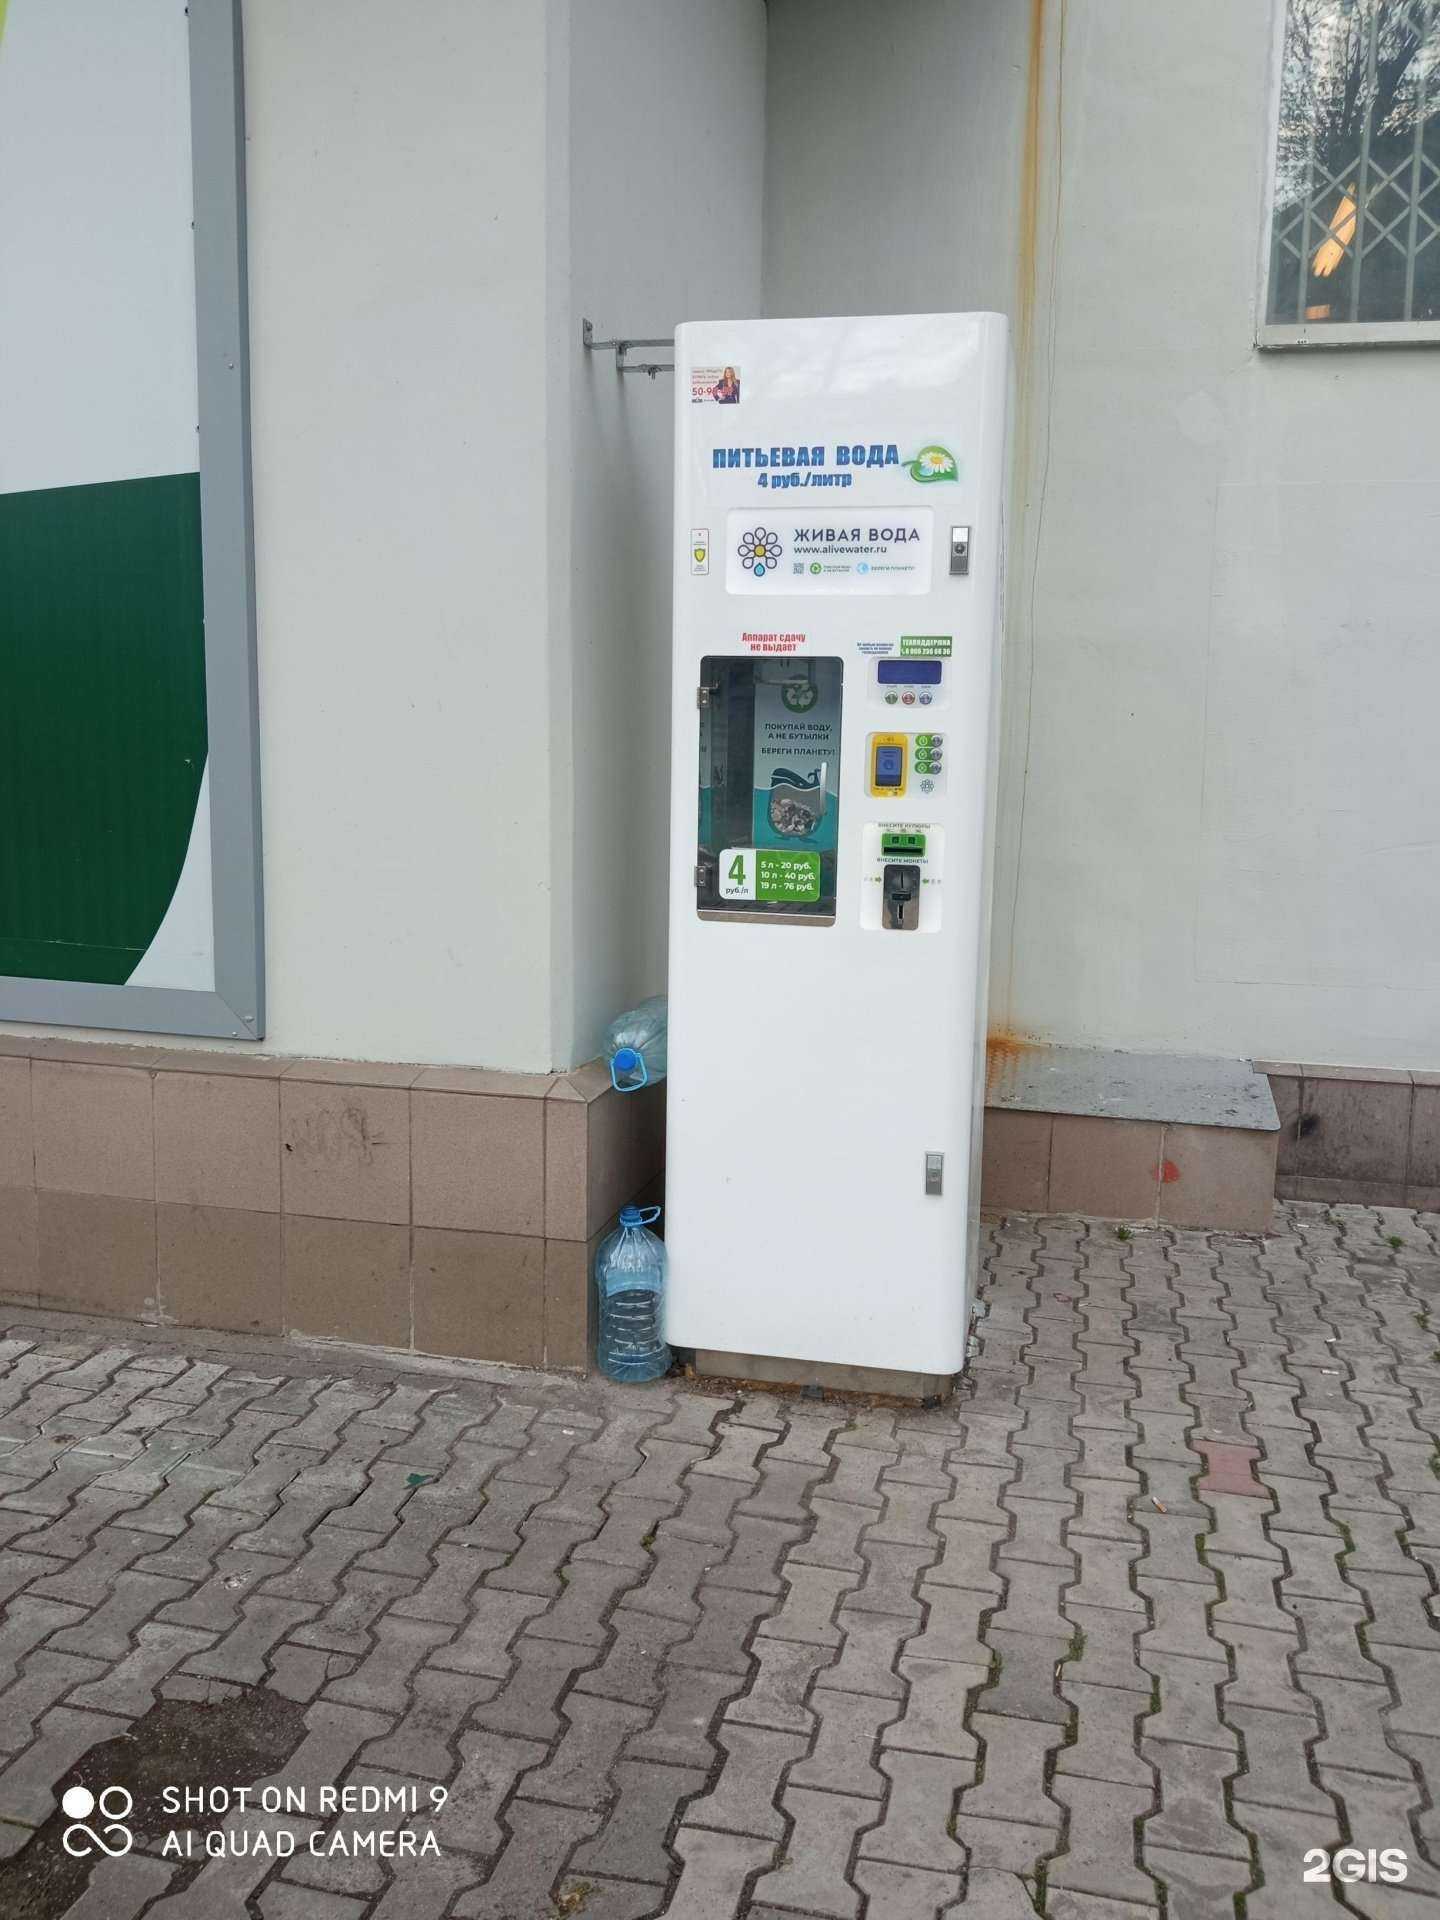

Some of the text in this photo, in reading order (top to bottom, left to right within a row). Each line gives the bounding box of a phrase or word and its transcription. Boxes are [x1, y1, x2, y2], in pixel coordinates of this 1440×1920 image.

[712, 444, 900, 468] ПИТЬЕВАЯ ВОДА
[757, 471, 852, 489] 4 руб./литр
[793, 528, 920, 543] ЖИВАЯ ВОДА
[793, 545, 887, 554] www.alivewater.ru
[742, 633, 806, 642] Аппарат сдачу
[762, 643, 797, 652] выдает
[765, 722, 833, 731] ПОКУПАЙ ВОДУ,
[761, 747, 835, 756] БЕРЕГИ ПЛАНЕТУ!
[728, 854, 746, 886] 4
[781, 861, 791, 869] 20
[794, 862, 812, 871] руб.
[784, 872, 796, 880] 40
[797, 872, 816, 881] руб.
[761, 881, 770, 889] 19
[784, 882, 795, 890] 76
[796, 883, 814, 891] руб.
